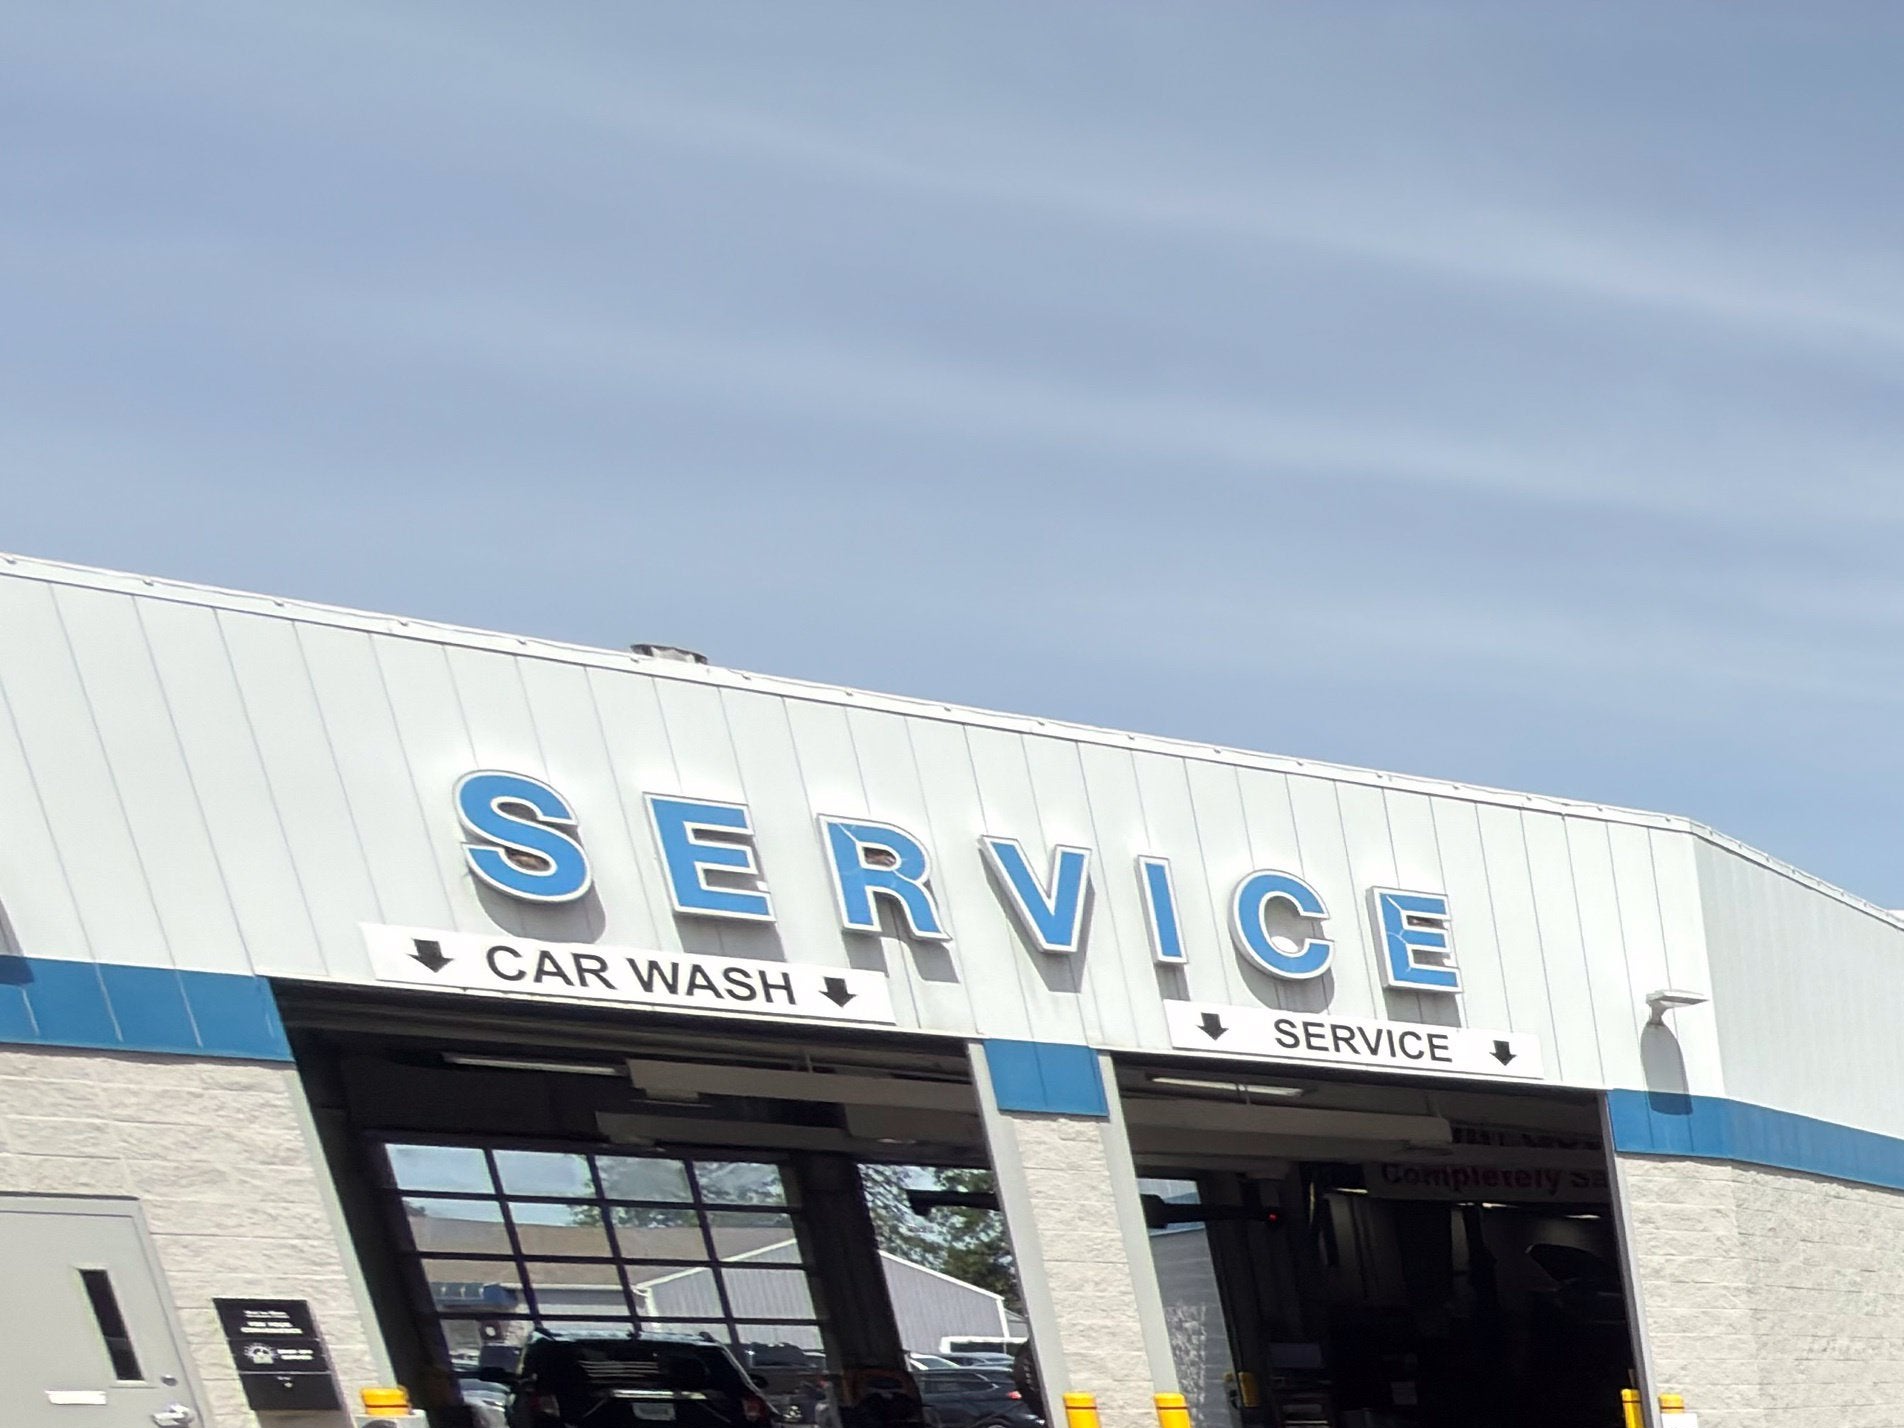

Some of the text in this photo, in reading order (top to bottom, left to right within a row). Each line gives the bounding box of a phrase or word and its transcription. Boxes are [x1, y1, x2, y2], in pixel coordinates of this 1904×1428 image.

[453, 769, 1463, 993] SERVICE
[486, 944, 797, 1005] CAR WASH
[1273, 1018, 1454, 1063] SERVICE
